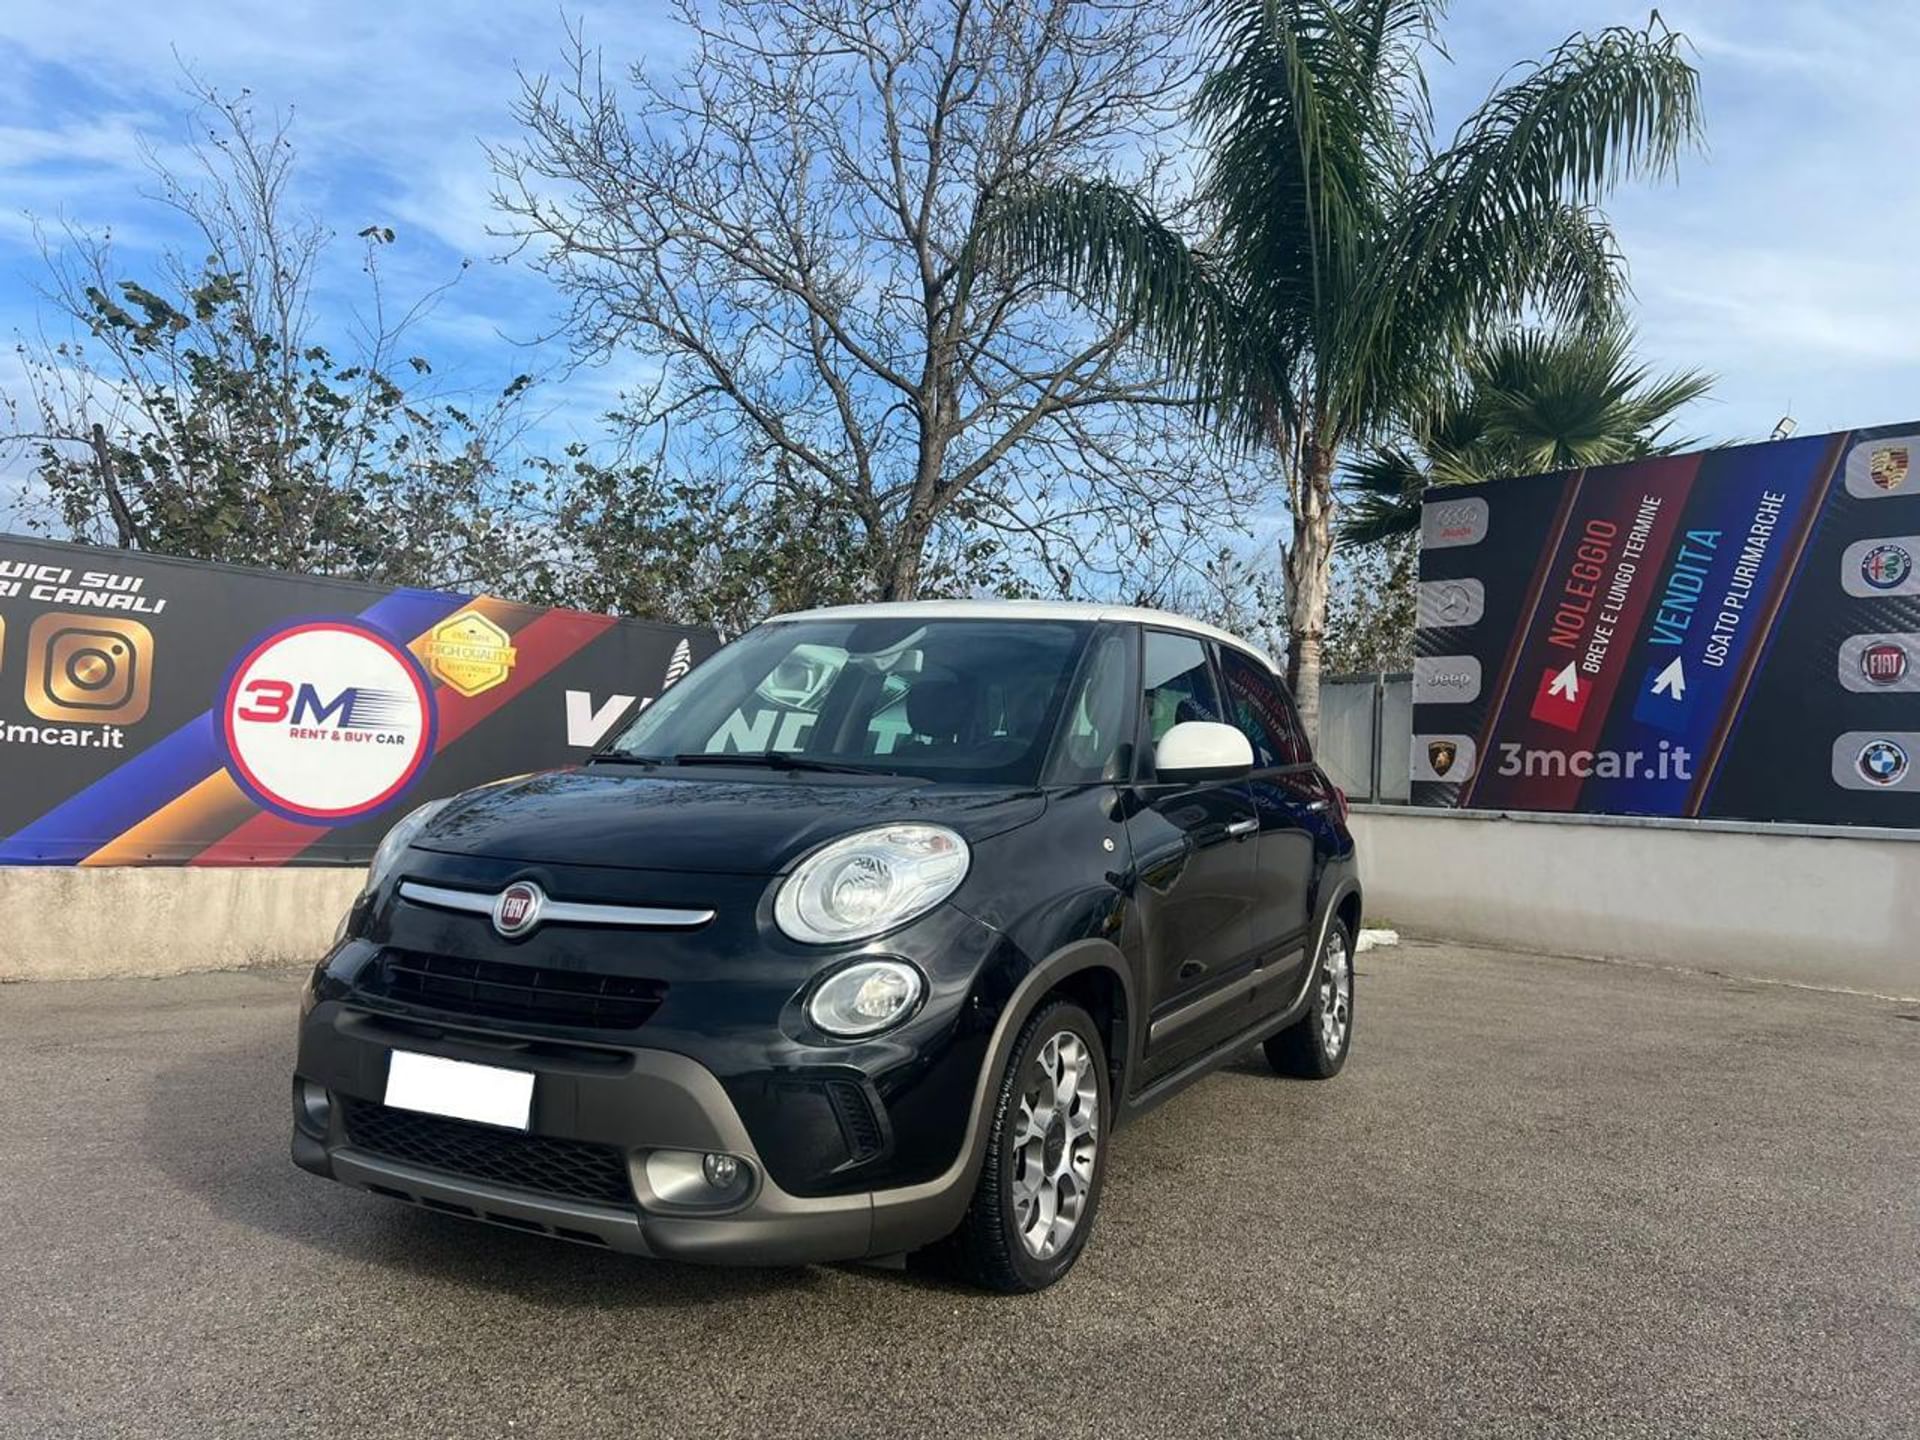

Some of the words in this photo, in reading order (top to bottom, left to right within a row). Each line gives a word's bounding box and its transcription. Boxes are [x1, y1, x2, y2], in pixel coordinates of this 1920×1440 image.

[1622, 494, 1662, 560] TERMINE
[79, 572, 144, 593] SUI
[1548, 519, 1617, 648] NOLEGGIO
[1605, 562, 1637, 612] LUNGO
[1648, 530, 1722, 645] VENDITA
[1702, 614, 1740, 667] USATO
[1724, 490, 1786, 609] PLURIMARCHE
[29, 584, 167, 614] CANALI
[1600, 611, 1619, 624] E
[1582, 624, 1614, 674] BREVE
[1870, 653, 1900, 676] FIAT
[1427, 669, 1471, 690] Jeep
[238, 679, 359, 729] 3M
[0, 720, 124, 748] mcar.it
[289, 728, 329, 741] RENT
[331, 731, 341, 742] &
[344, 731, 373, 743] BUY
[376, 734, 406, 746] CAR
[1498, 740, 1692, 780] 3mcar.it
[502, 897, 529, 919] FIAT
